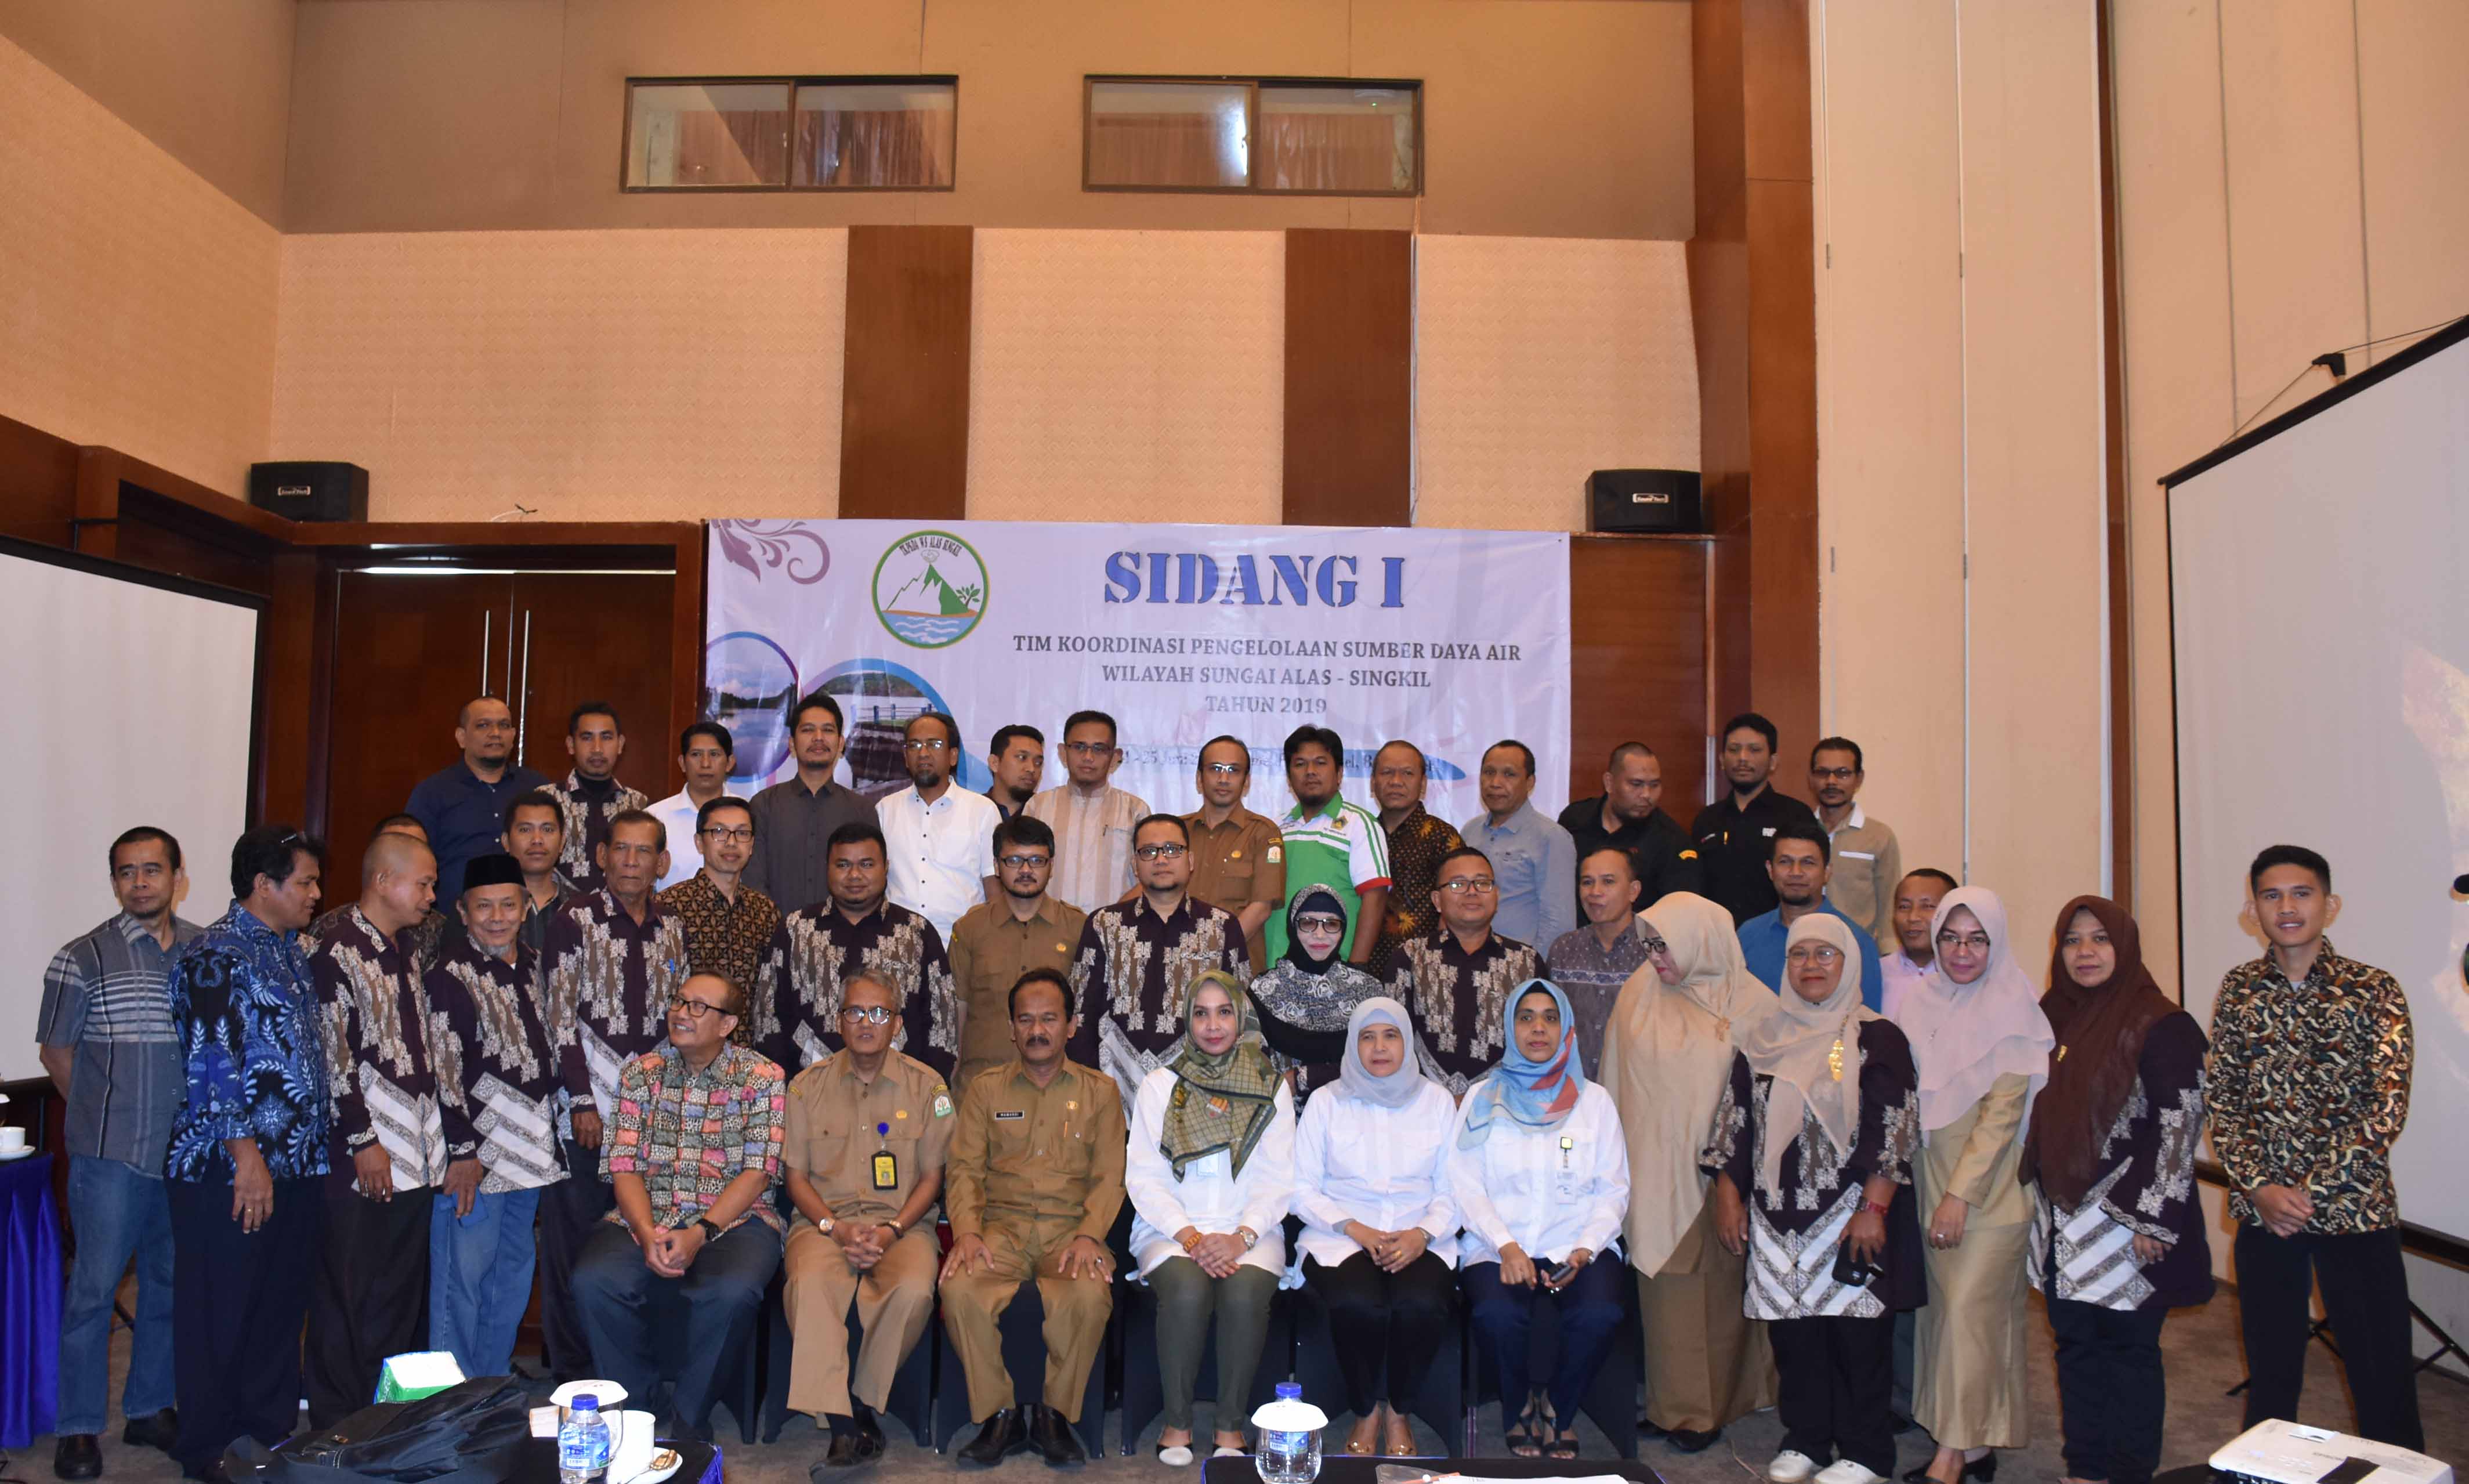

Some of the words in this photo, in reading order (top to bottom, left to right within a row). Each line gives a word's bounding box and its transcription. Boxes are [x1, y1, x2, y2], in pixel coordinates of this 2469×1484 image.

[1105, 551, 1357, 607] SIDANG
[1381, 557, 1405, 607] I
[1013, 635, 1052, 651] TIM
[1058, 636, 1185, 654] KOORDINASI
[1190, 639, 1337, 657] PENGELOLAAN
[1342, 641, 1425, 658] SUMBER
[1431, 643, 1481, 660] DAYA
[1485, 645, 1521, 661] AIR
[1102, 665, 1194, 682] WILAYAH
[1200, 667, 1276, 684] SUNGAI
[1280, 668, 1332, 686] ALAS
[1349, 669, 1431, 687] SINGKIL
[1205, 696, 1275, 713] TAHUN
[1280, 697, 1327, 714] 2019
